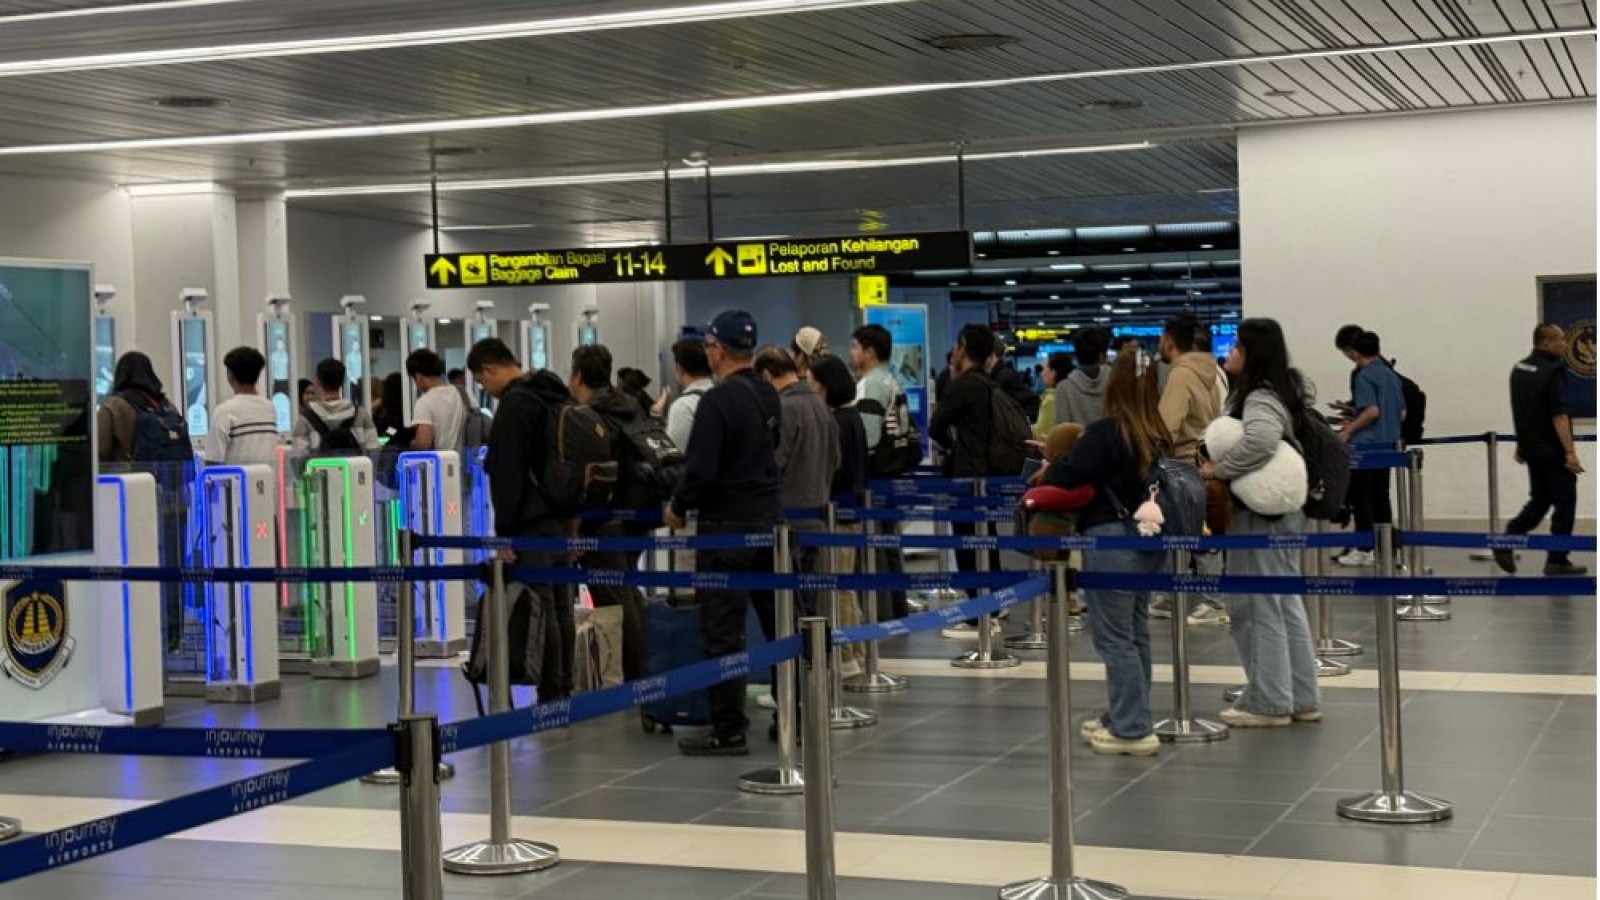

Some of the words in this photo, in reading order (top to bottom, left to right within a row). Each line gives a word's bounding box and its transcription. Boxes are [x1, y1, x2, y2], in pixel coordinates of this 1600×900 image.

[769, 242, 838, 258] Pelaporan
[841, 238, 919, 254] Kehilangan
[489, 252, 564, 269] Pengambilan
[566, 250, 606, 267] Bagasi
[613, 252, 666, 277] 11-14
[769, 259, 799, 273] Lost
[802, 258, 828, 271] and
[832, 256, 876, 270] Found
[490, 268, 542, 284] Baggage
[545, 265, 579, 279] Claim
